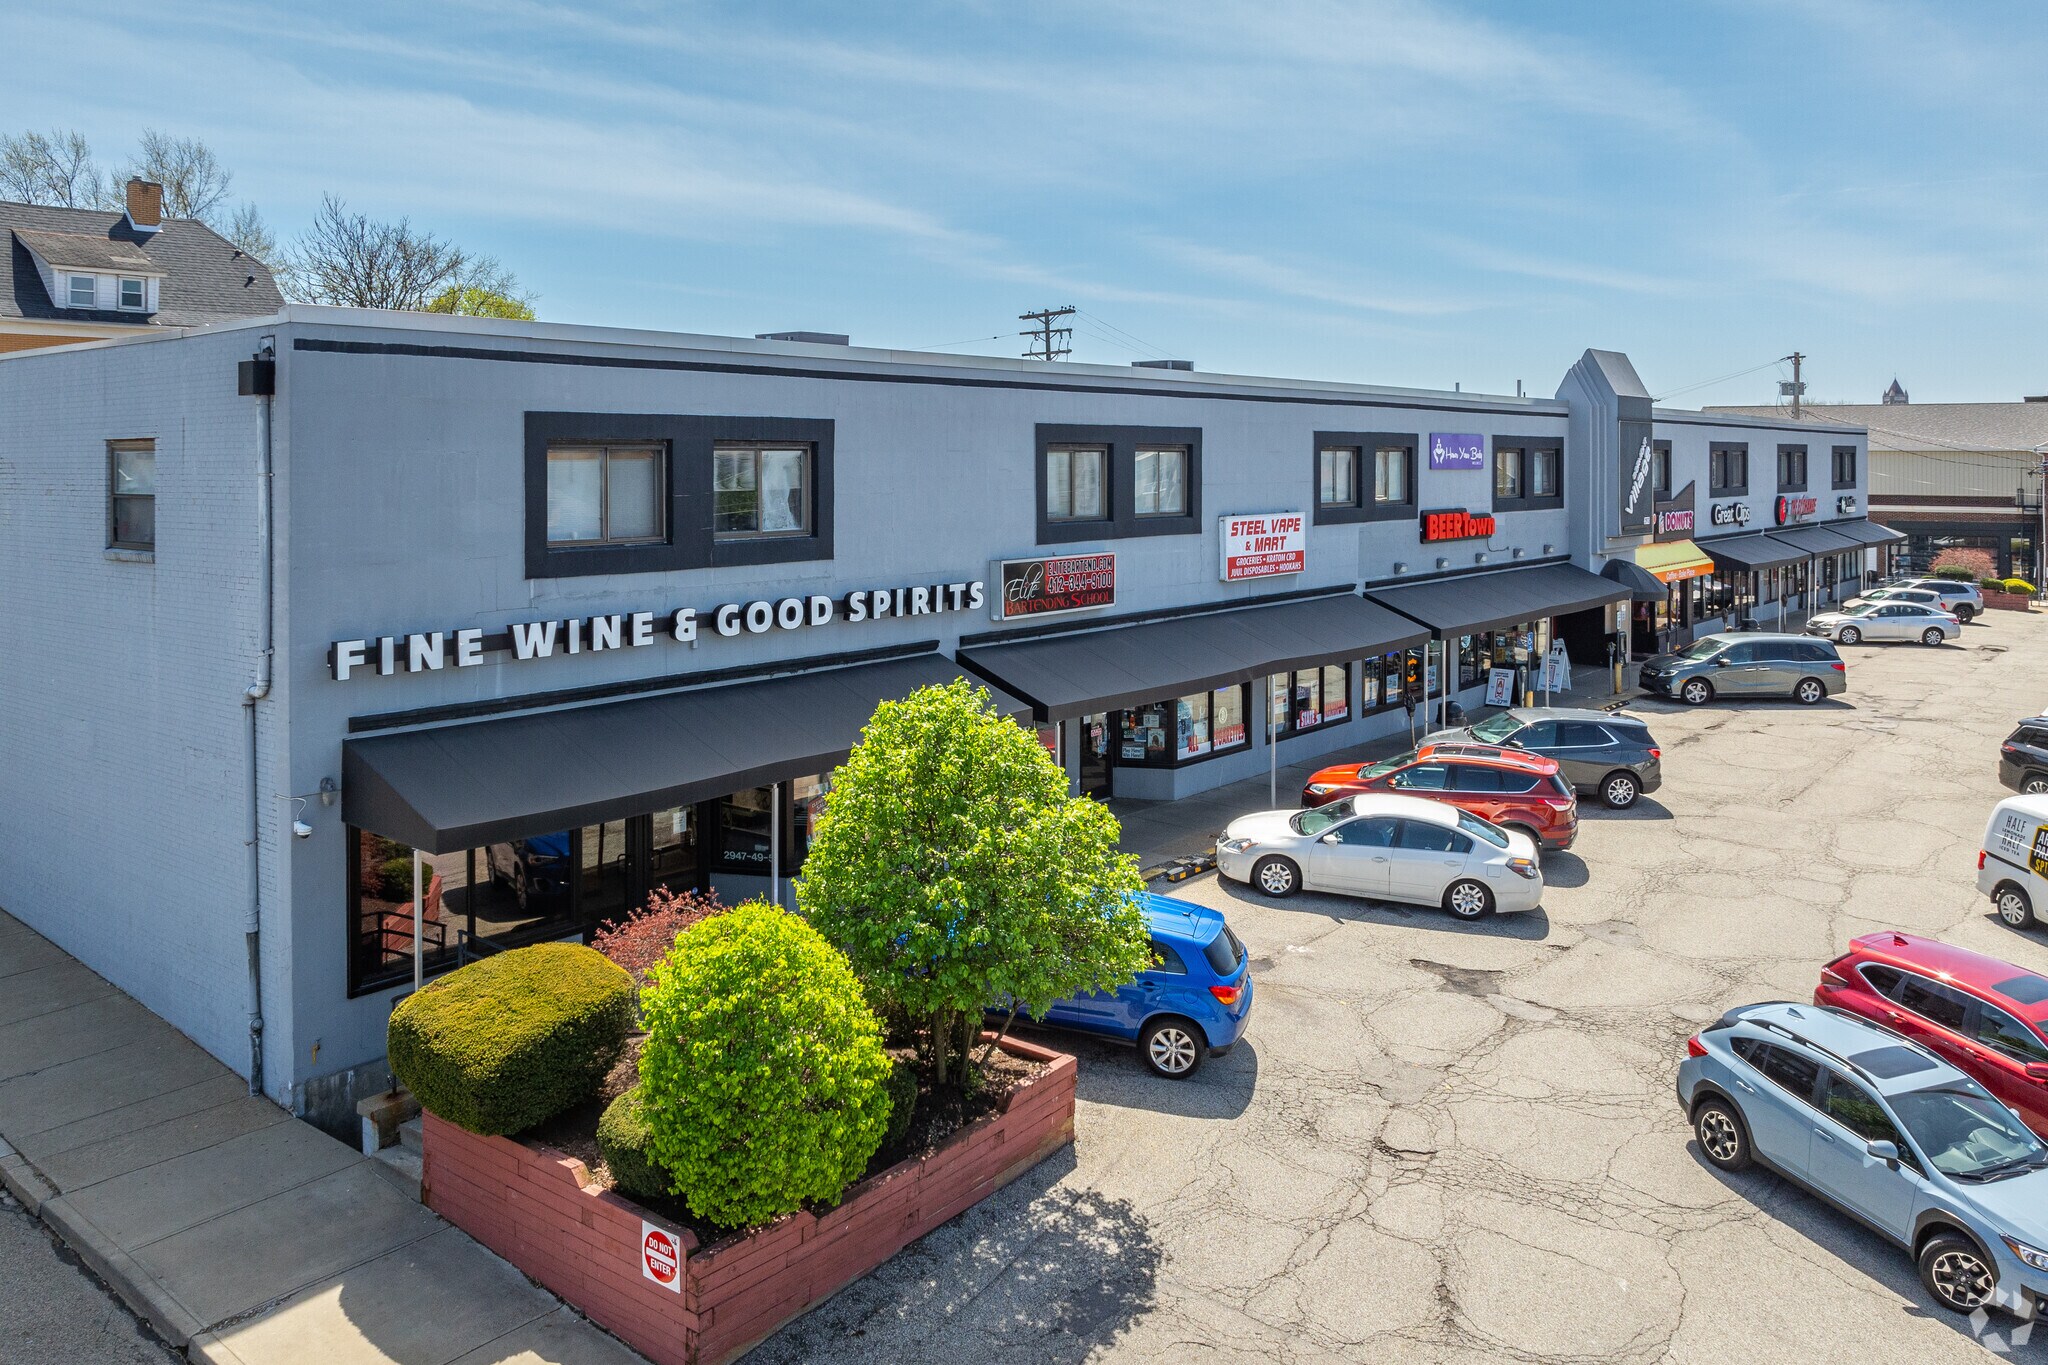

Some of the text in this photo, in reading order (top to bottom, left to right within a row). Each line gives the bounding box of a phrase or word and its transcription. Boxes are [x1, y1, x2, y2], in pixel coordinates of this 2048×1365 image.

[1625, 446, 1651, 514] Village
[1665, 511, 1693, 531] DONUTS
[1715, 504, 1750, 524] Great Clips
[1231, 517, 1301, 537] STEEL VAPE
[1245, 536, 1287, 552] & MART
[1047, 556, 1113, 577] ELITEBARTEND.COM
[1236, 552, 1296, 566] GROCERIES KRATOM CBD
[1231, 568, 1243, 577] JUUL
[1244, 564, 1275, 575] DISPOSABLES
[1005, 562, 1044, 602] Elite
[1047, 571, 1113, 594] 412-344-9100
[1005, 591, 1112, 616] BARTENDING SCHOOL
[332, 581, 985, 681] FINE WINE & GOOD SPIRITS
[2002, 828, 2025, 840] LEMONADE
[2006, 815, 2026, 833] HALF
[649, 1237, 658, 1249] DO
[659, 1242, 672, 1257] NOT
[650, 1257, 671, 1276] ENTER
